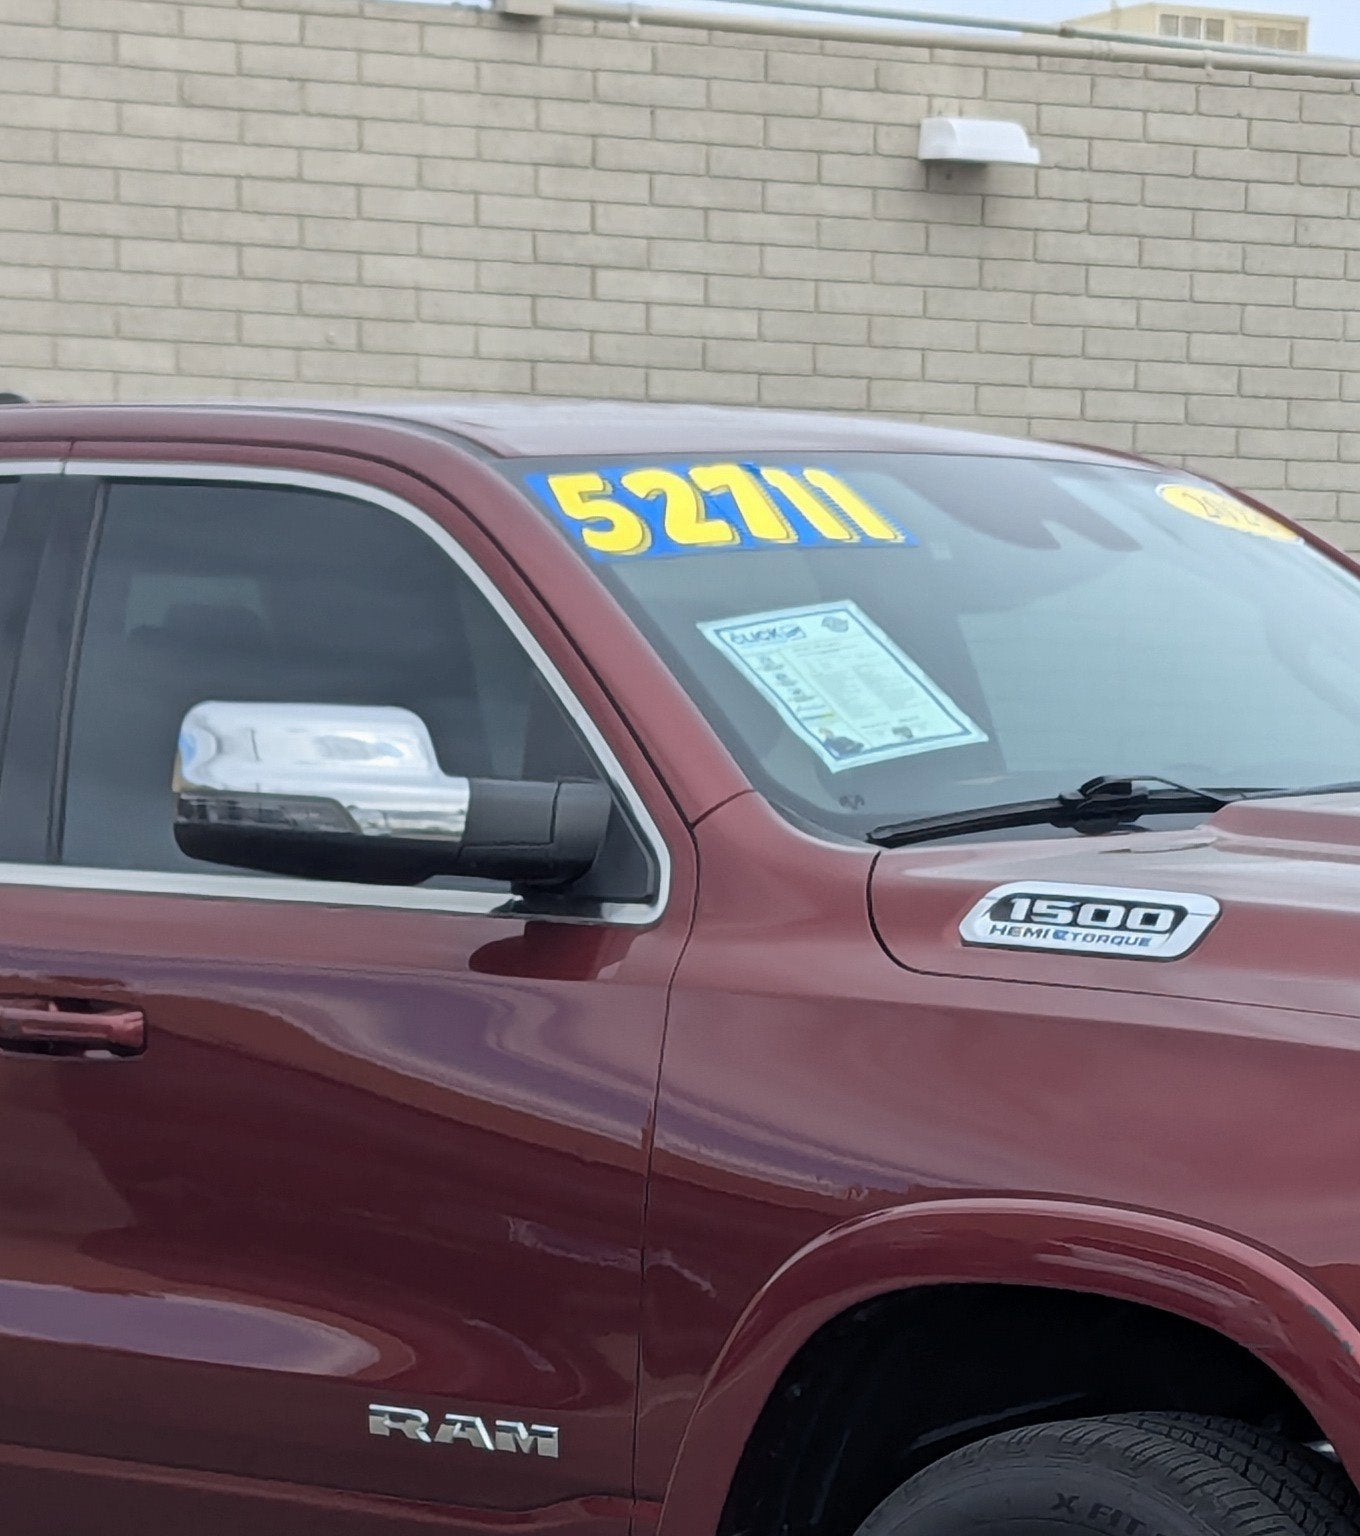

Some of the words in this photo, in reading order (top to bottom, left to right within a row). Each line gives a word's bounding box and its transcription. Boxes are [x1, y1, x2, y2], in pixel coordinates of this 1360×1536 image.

[547, 464, 904, 555] 52711
[989, 923, 1049, 940] HEMI
[1009, 897, 1176, 932] 1500
[368, 1403, 559, 1458] RAM
[1049, 1492, 1081, 1514] X
[1088, 1502, 1148, 1536] FIT
